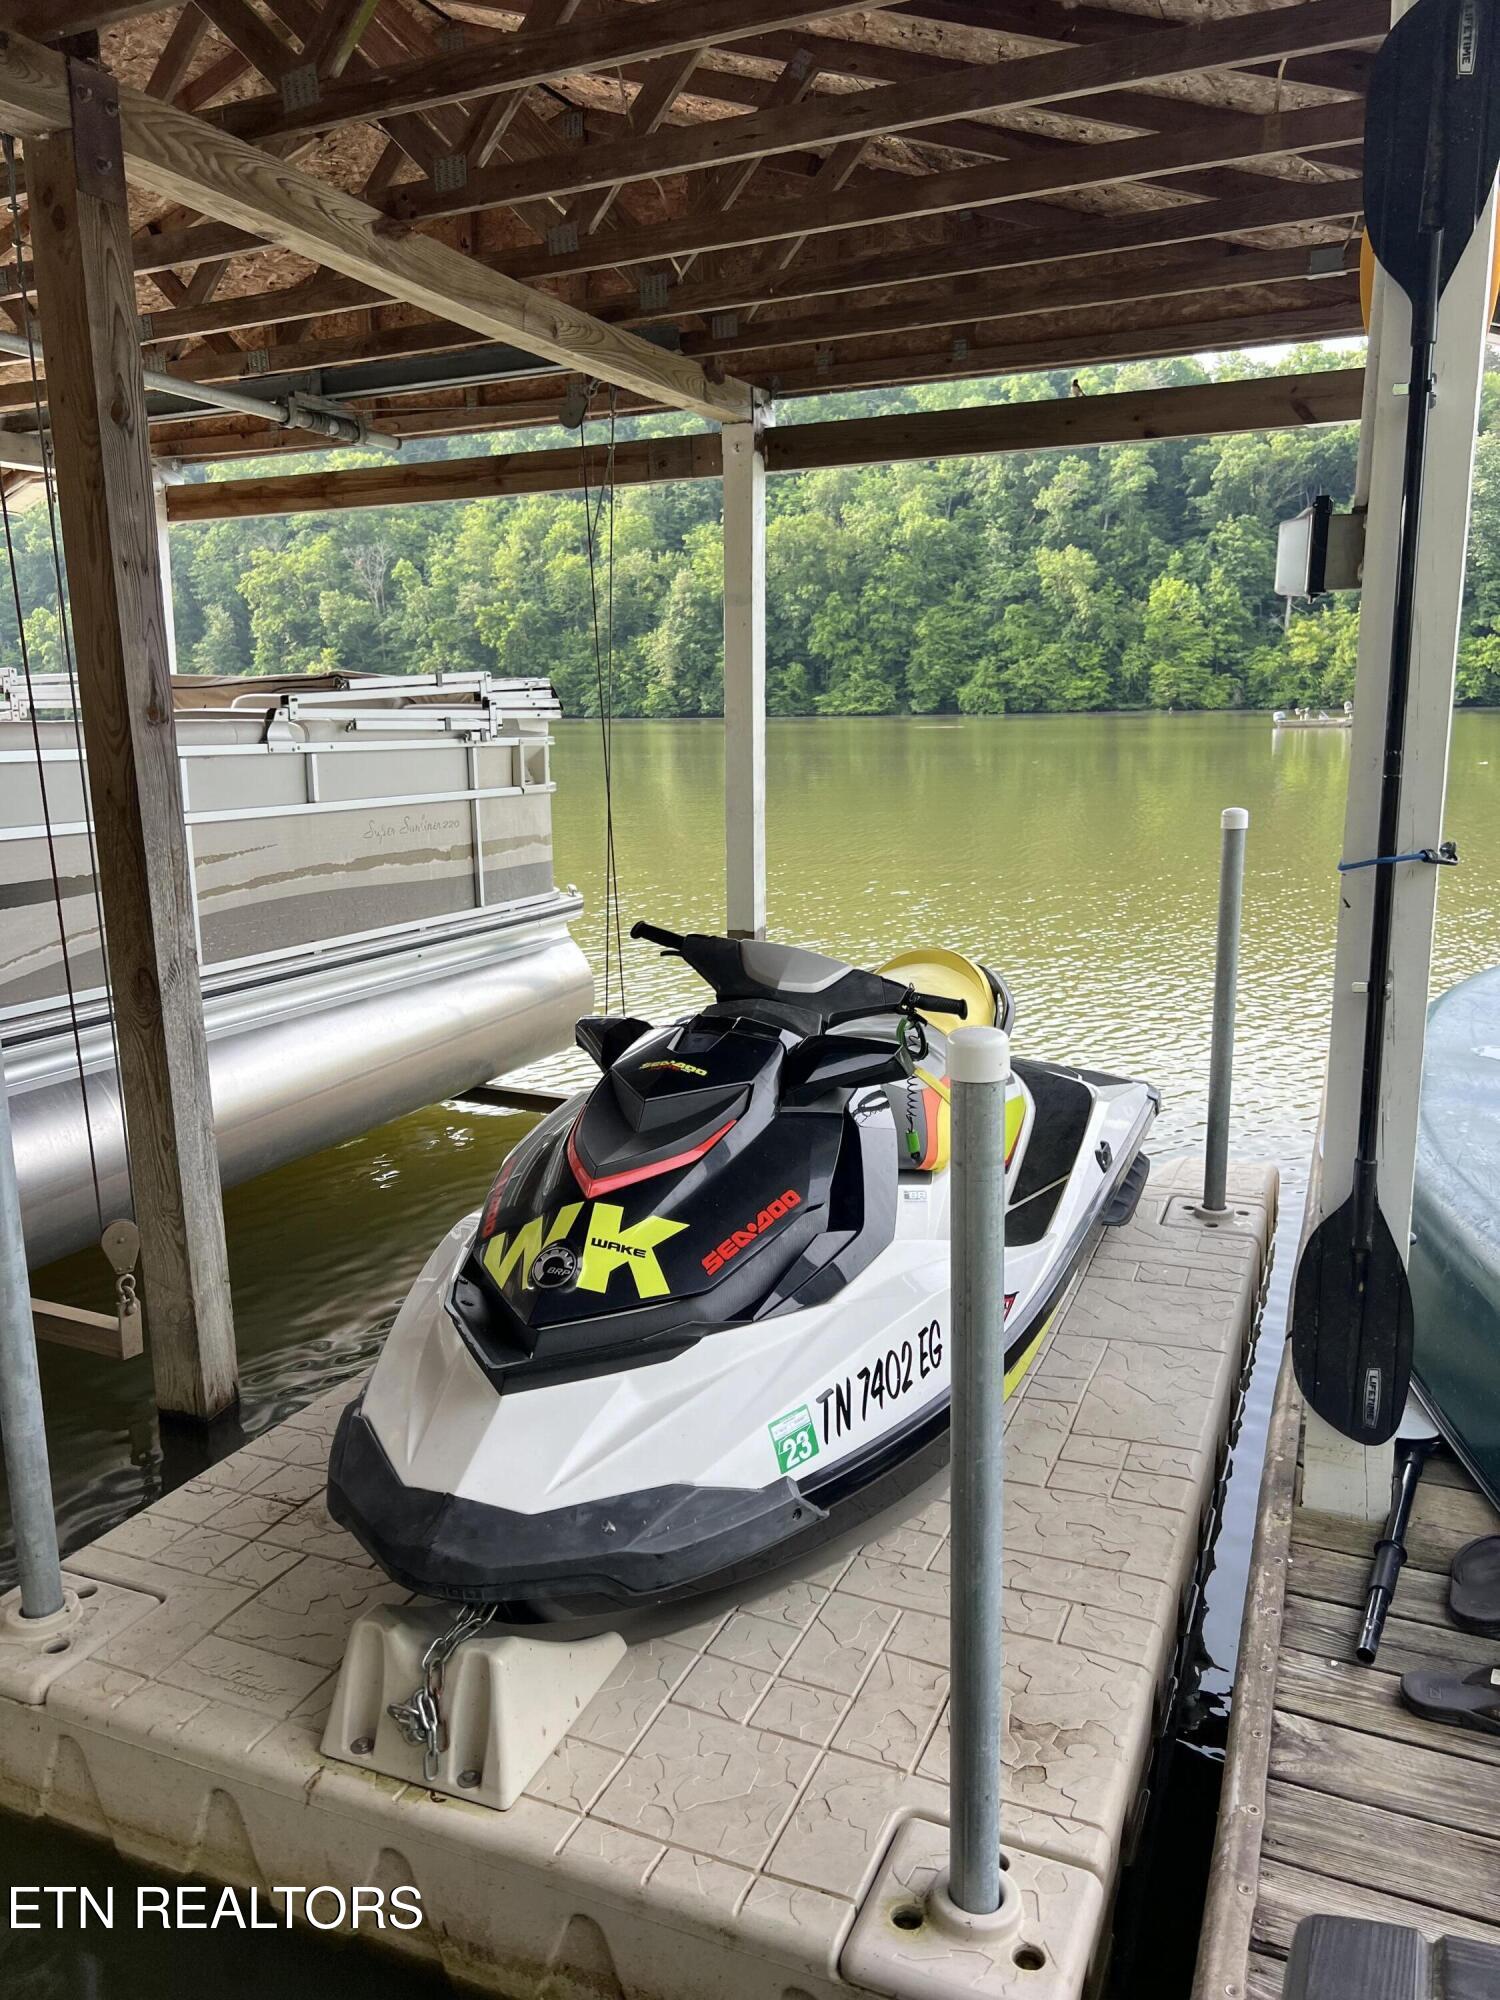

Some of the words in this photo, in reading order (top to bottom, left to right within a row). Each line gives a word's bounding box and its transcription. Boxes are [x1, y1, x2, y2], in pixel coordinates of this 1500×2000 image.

[1462, 4, 1473, 66] LIFETIME
[442, 820, 460, 829] 220
[590, 1237, 647, 1259] WAKE
[546, 1265, 572, 1277] BRP
[816, 1387, 851, 1445] TN
[857, 1341, 913, 1421] 7402
[918, 1319, 943, 1379] EG
[1366, 1375, 1378, 1421] LIFETIME
[783, 1431, 812, 1469] 23
